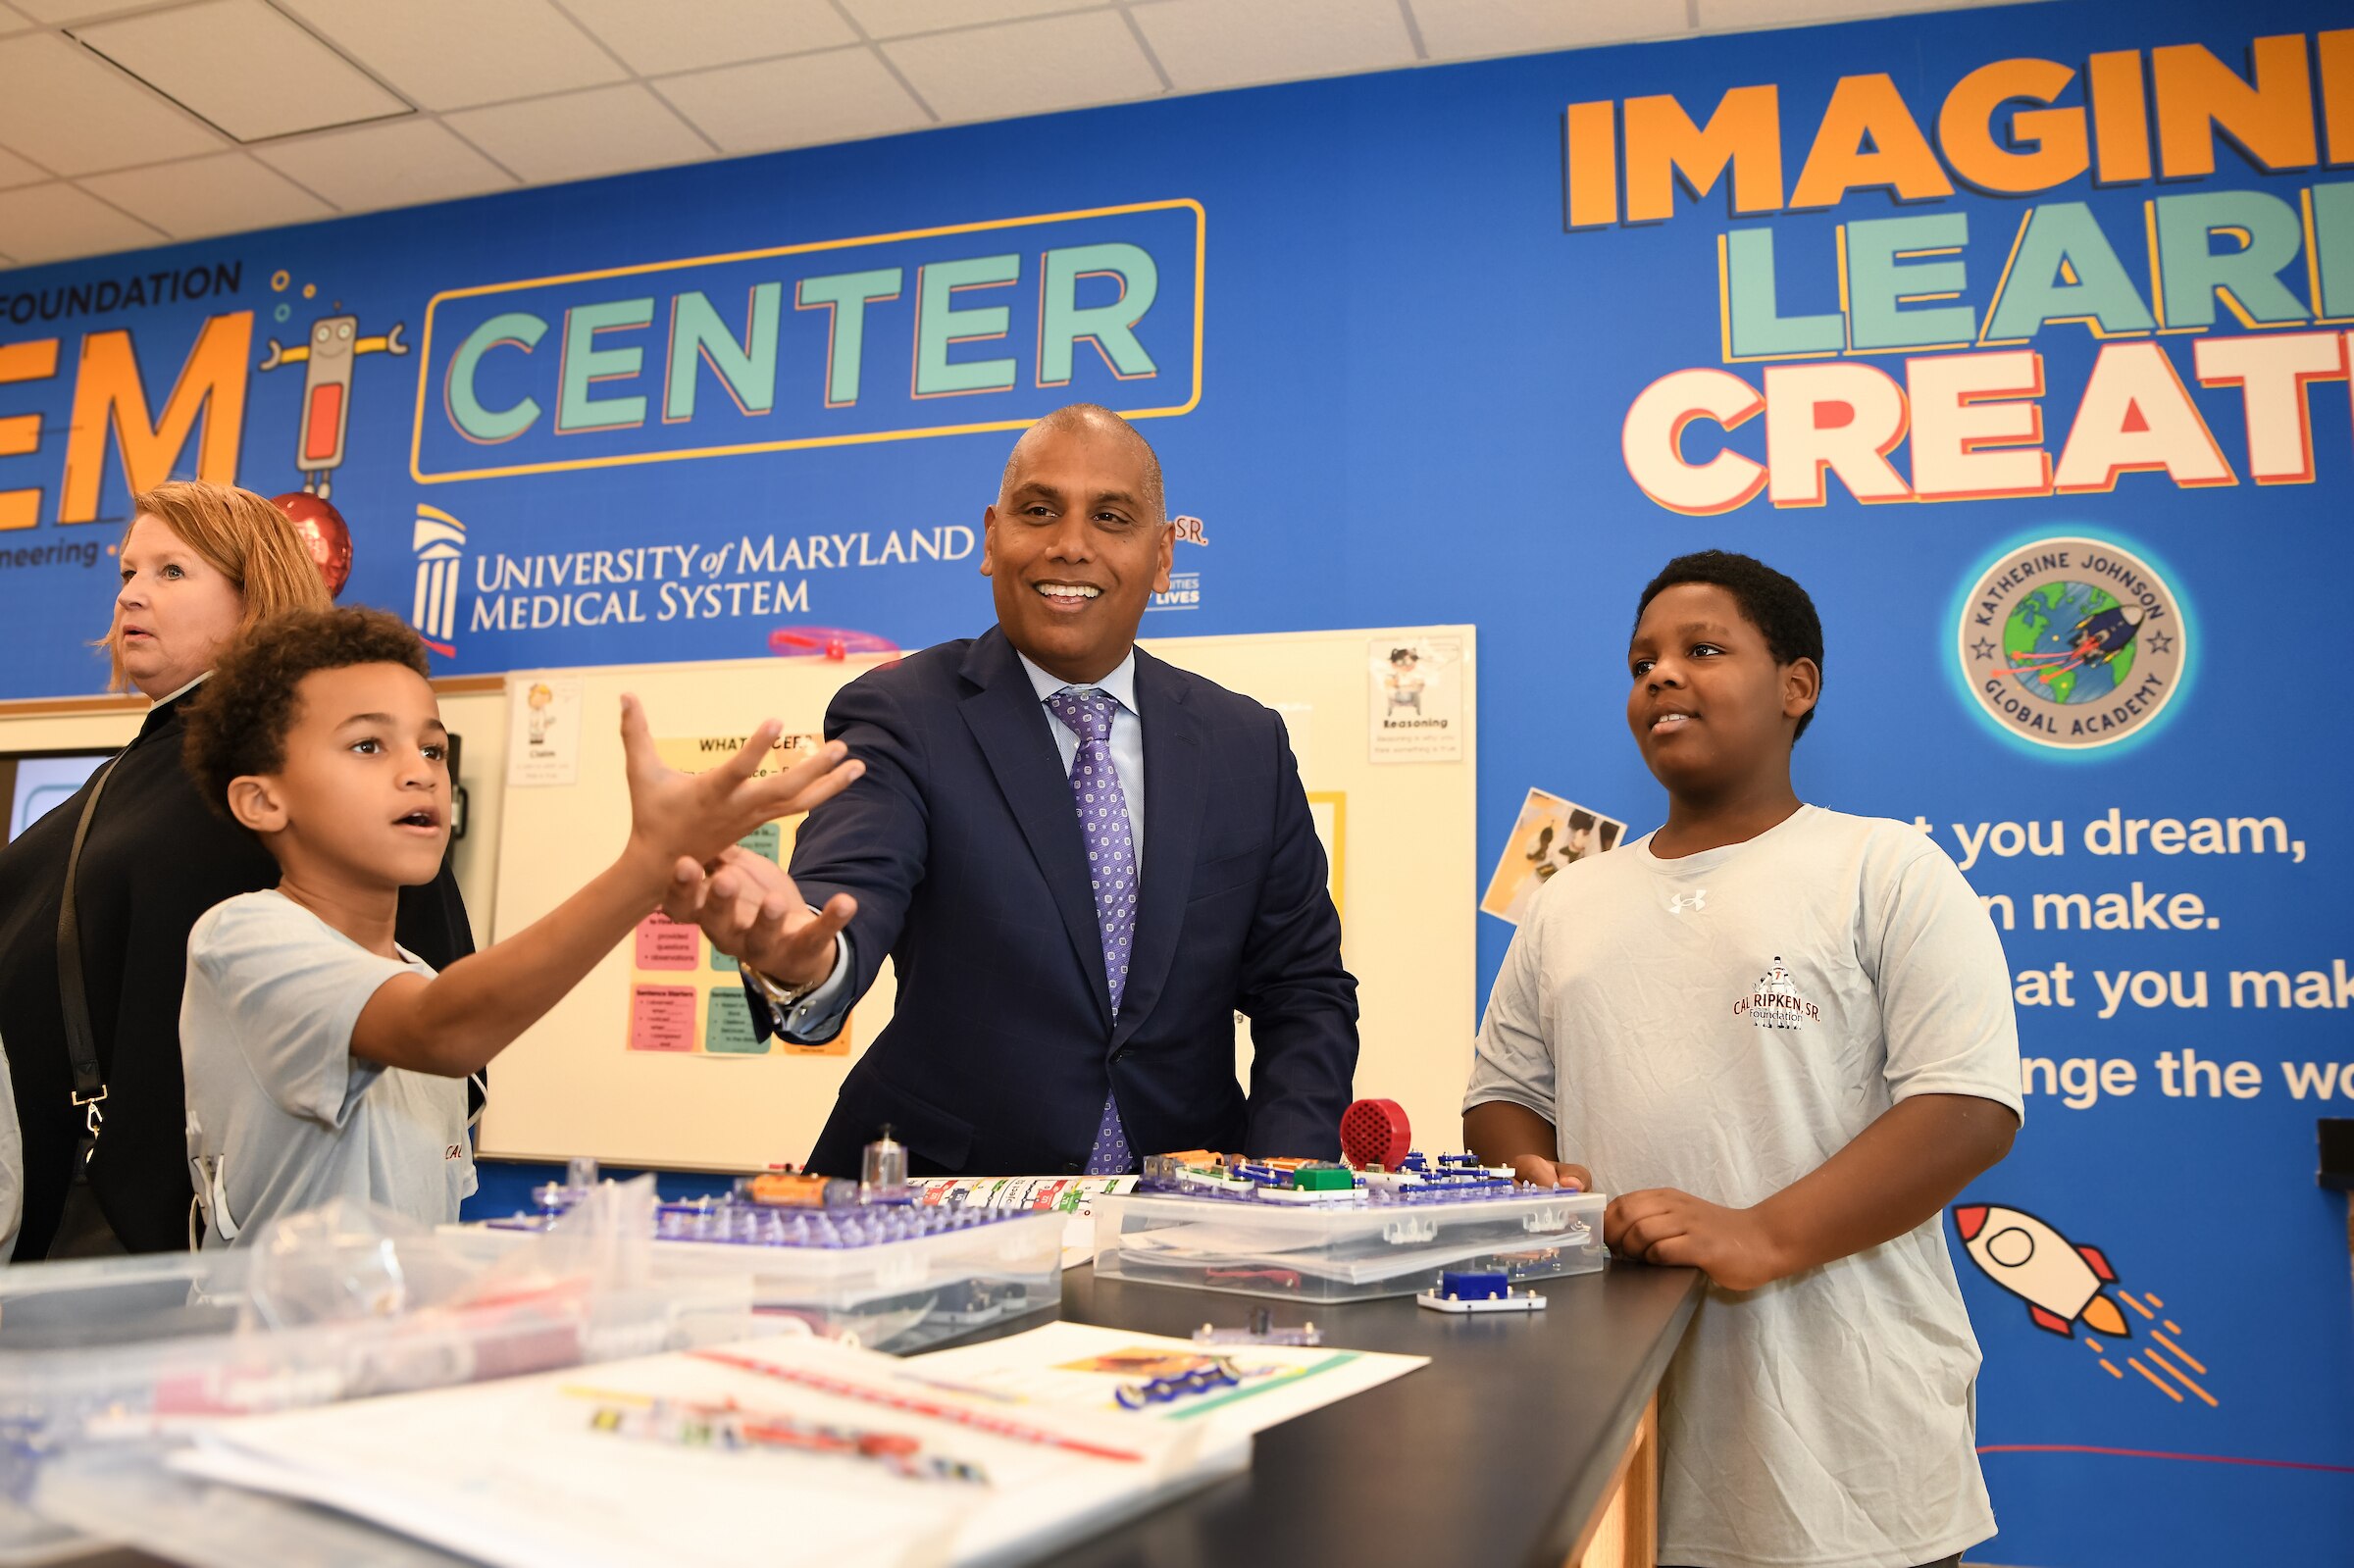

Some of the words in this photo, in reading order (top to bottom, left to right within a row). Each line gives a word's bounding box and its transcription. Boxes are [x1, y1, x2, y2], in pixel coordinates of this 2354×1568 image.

[445, 242, 1159, 444] CENTER
[1622, 329, 2354, 516] CREAT
[1176, 517, 1206, 544] SR.
[476, 543, 700, 592] UNIVERSITY
[699, 542, 734, 579] of
[737, 525, 975, 575] MARYLAND
[470, 589, 645, 632] MEDICAL
[657, 580, 810, 621] SYSTEM
[1156, 590, 1201, 605] LIVES
[1169, 578, 1199, 590] ITIES
[1974, 552, 2070, 627] KATHERINE
[2081, 553, 2165, 621] JOHNSON
[1383, 718, 1448, 729] Reasoning
[1984, 679, 2058, 734] GLOBAL
[2071, 673, 2164, 735] ACADEMY
[699, 736, 747, 752] WHAT
[1952, 820, 2065, 871] you
[2083, 808, 2306, 863] dream,
[2032, 882, 2220, 931] make.
[1775, 971, 1781, 981] 7
[2093, 970, 2208, 1019] you
[1733, 996, 1751, 1015] CAL
[1754, 993, 1804, 1014] RIPKEN,
[1805, 1002, 1820, 1022] SR.
[1750, 1009, 1803, 1022] Foundation
[2155, 1048, 2262, 1099] the
